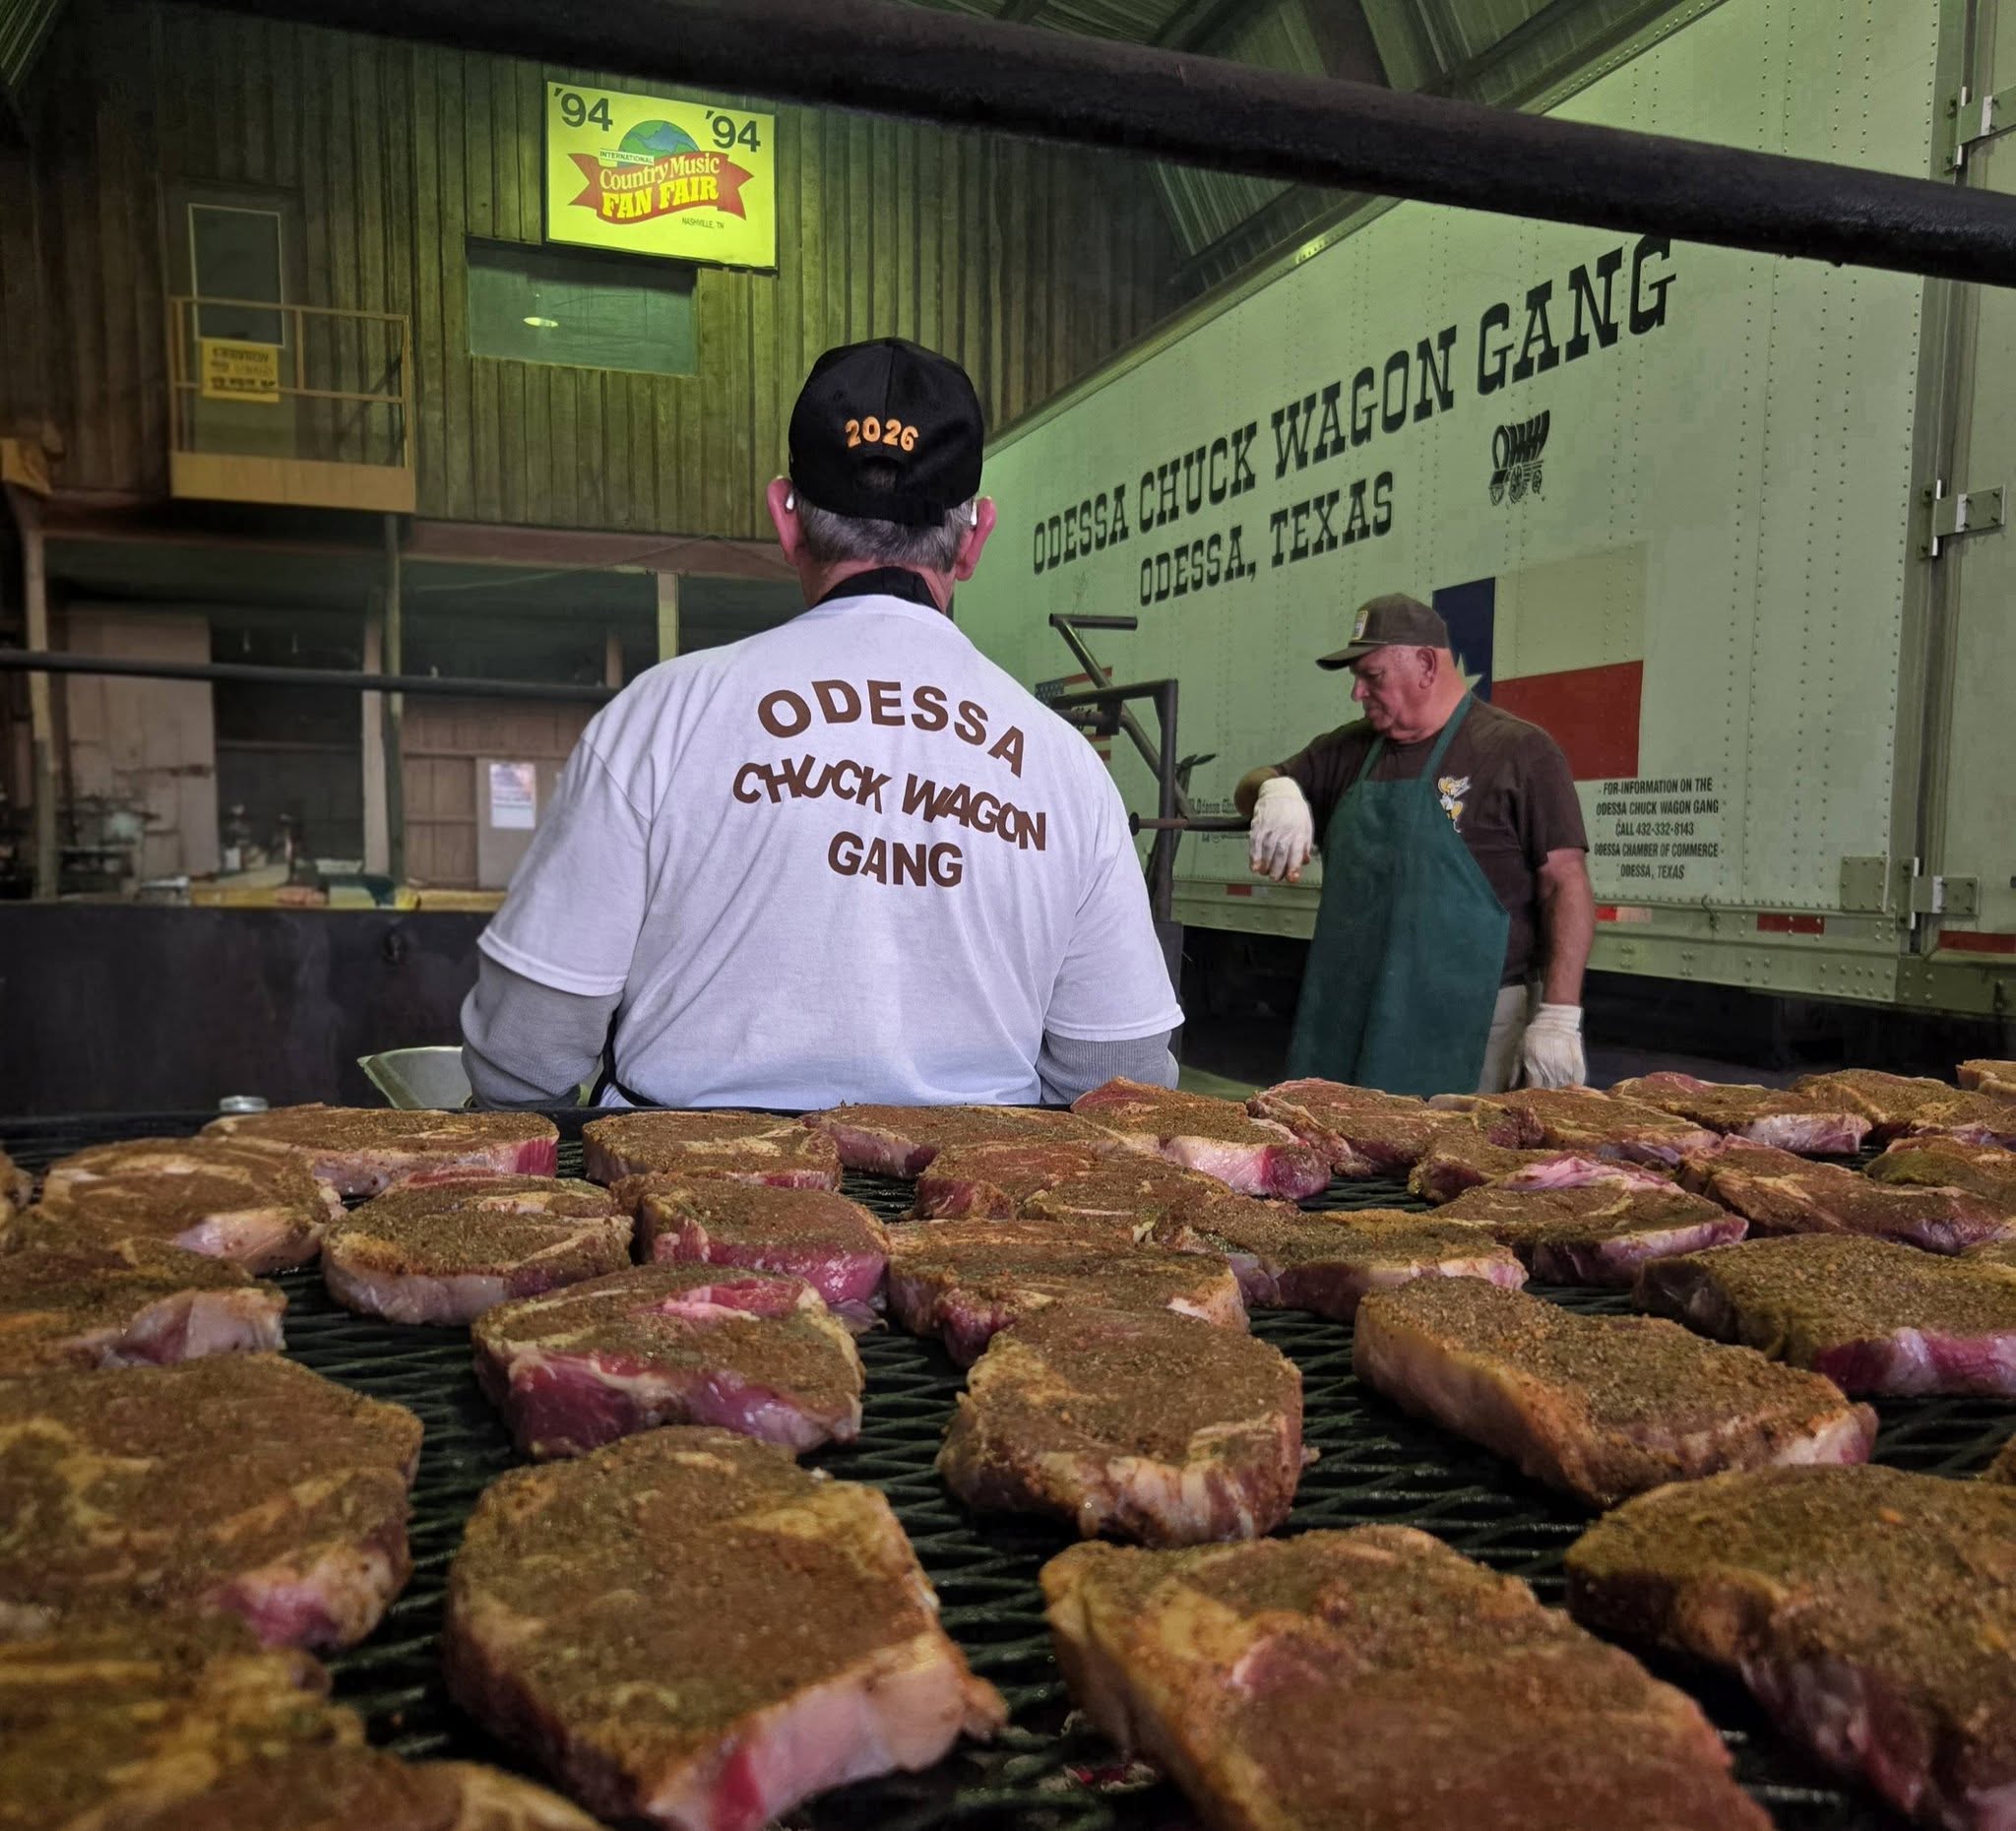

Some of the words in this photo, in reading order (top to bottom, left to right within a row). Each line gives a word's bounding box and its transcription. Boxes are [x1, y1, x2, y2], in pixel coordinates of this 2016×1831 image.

[599, 151, 654, 164] INTERNATIONAL
[599, 160, 669, 190] Country
[669, 153, 721, 178] Music
[601, 187, 653, 219] FAN
[659, 175, 720, 210] FAIR
[1034, 483, 1129, 575] ODESSA
[1139, 421, 1257, 535] CHUCK
[1271, 325, 1457, 480] WAGON
[1478, 234, 1676, 396] GANG
[845, 415, 919, 452] 2026
[1140, 526, 1256, 606] ODESSA,
[1270, 472, 1393, 568] TEXAS
[757, 679, 1025, 779] ODESSA
[732, 754, 893, 814] CHUCK
[902, 773, 1046, 851] WAGON
[1603, 783, 1618, 795] FOR
[1620, 779, 1678, 794] INFORMATION
[1680, 778, 1692, 792] ON
[1694, 777, 1713, 792] THE
[1596, 801, 1627, 816] ODESSA
[1629, 800, 1657, 815] CHUCK
[1660, 799, 1691, 815] WAGON
[1693, 798, 1719, 814] GANG
[1615, 821, 1634, 837] CALL
[828, 831, 963, 887] GANG
[1594, 843, 1620, 856] ODESSA
[1622, 843, 1658, 857] CHAMBER
[1660, 843, 1670, 857] OF
[1671, 843, 1719, 857] COMMERCE
[1620, 863, 1654, 880] ODESSA,
[1658, 864, 1684, 880] TEXAS
